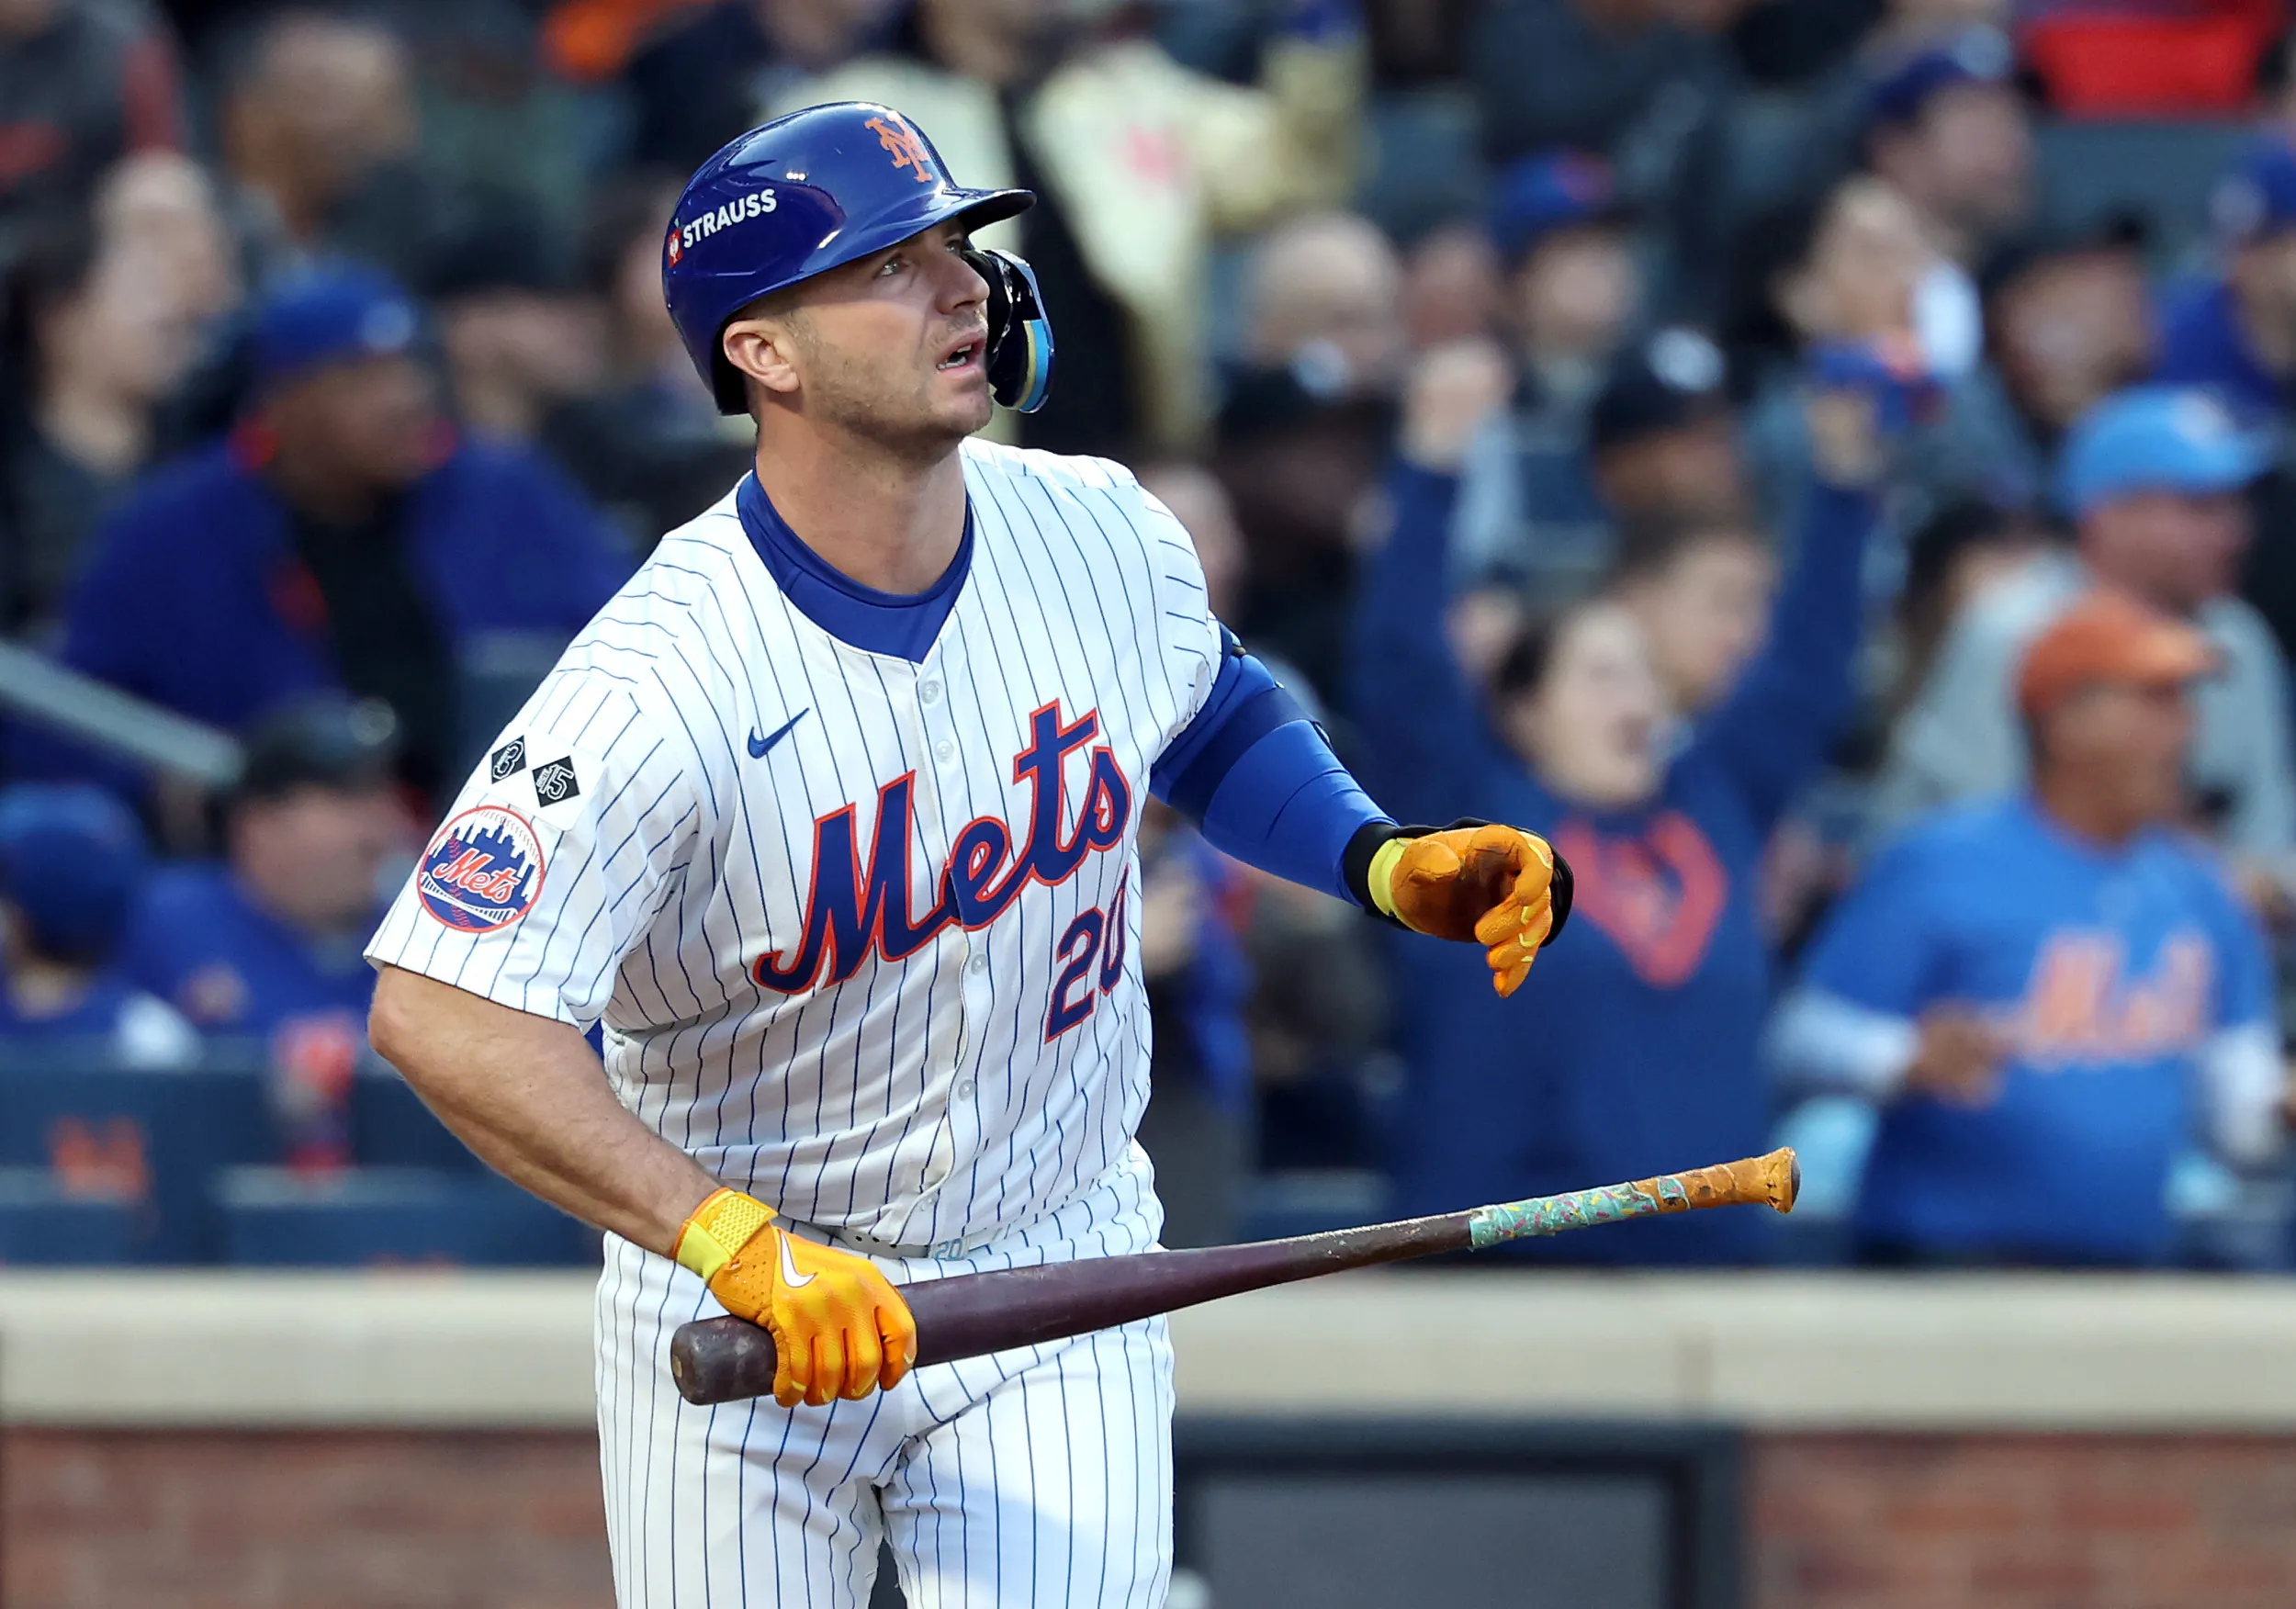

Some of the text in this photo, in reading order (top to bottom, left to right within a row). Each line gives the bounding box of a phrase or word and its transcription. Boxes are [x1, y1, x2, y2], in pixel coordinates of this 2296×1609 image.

[682, 188, 777, 249] STRAUSS
[539, 764, 574, 800] 15
[753, 698, 1131, 995] Mets
[433, 848, 520, 904] Mets
[1044, 862, 1130, 1043] 20
[934, 1238, 962, 1262] 20
